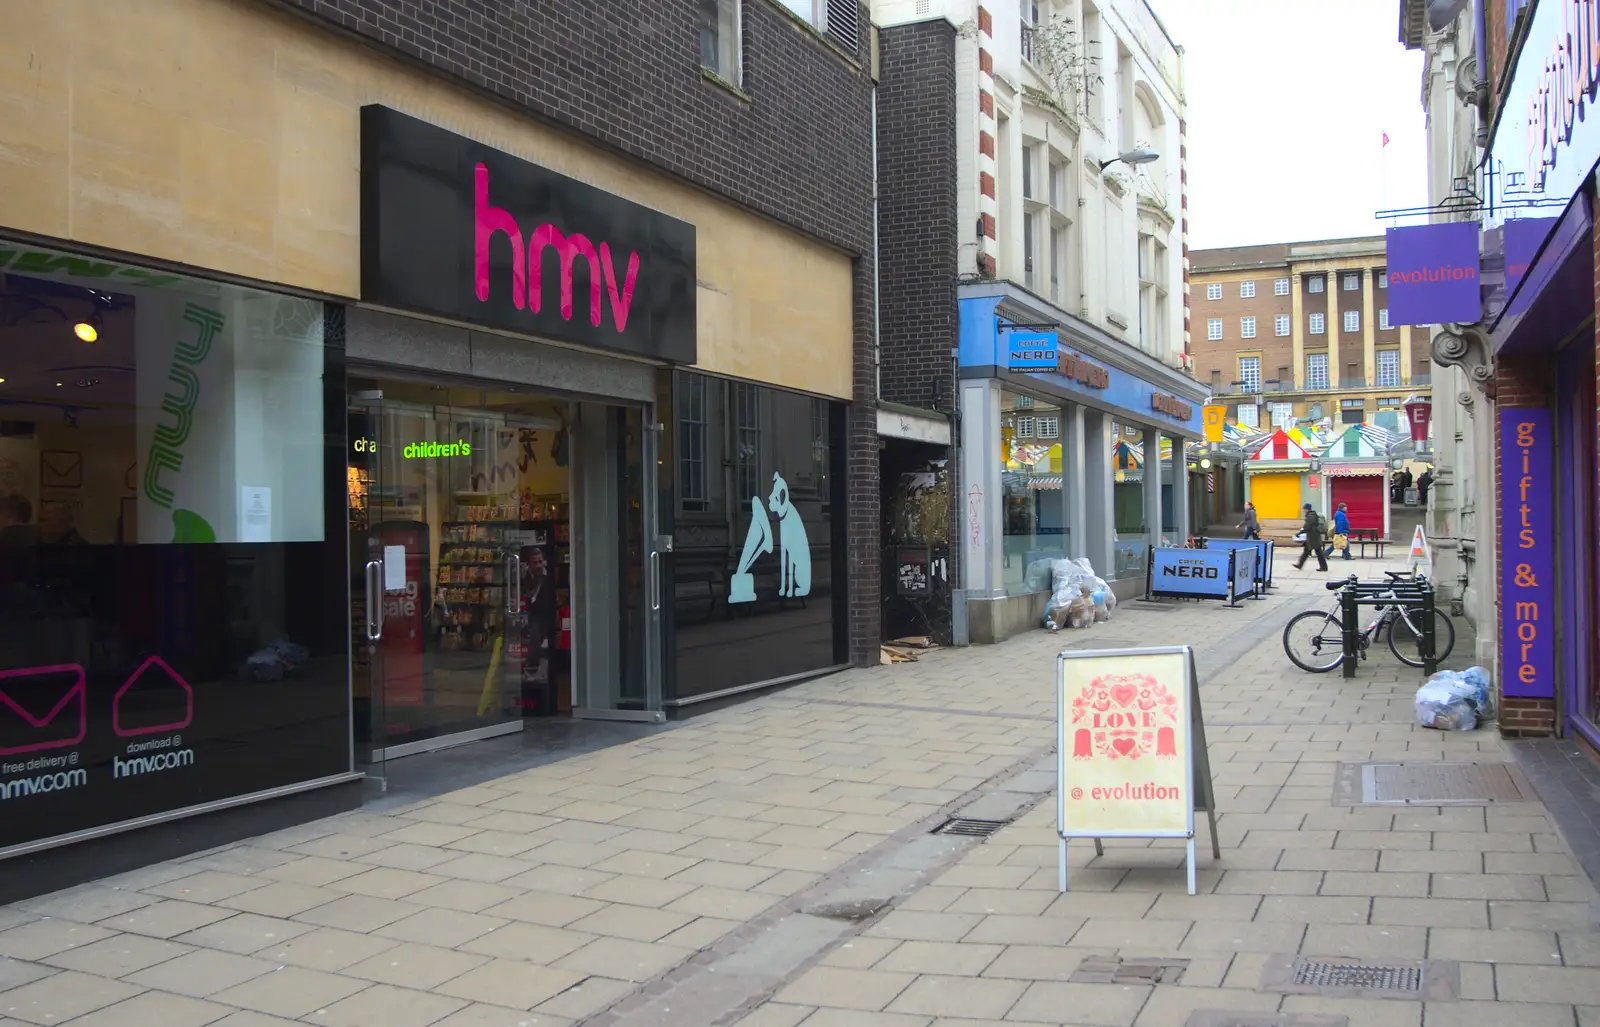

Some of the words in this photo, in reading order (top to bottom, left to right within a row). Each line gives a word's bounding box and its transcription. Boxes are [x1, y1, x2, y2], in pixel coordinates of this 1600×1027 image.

[475, 162, 639, 333] hmv
[1390, 265, 1476, 284] evolution
[1011, 350, 1055, 360] NERO
[1208, 411, 1219, 424] D
[1413, 408, 1424, 423] E
[403, 439, 471, 459] children's
[1517, 422, 1536, 549] gifts
[1163, 565, 1218, 579] NERO
[1514, 563, 1539, 587] &
[1515, 601, 1538, 683] more
[1092, 712, 1157, 728] LOVE
[127, 737, 171, 753] download
[172, 735, 181, 747] @
[2, 762, 25, 774] free
[26, 755, 68, 770] delivery
[68, 751, 79, 765] @
[113, 749, 194, 778] hmv.com
[1071, 786, 1084, 800] @
[1091, 782, 1179, 801] evolution
